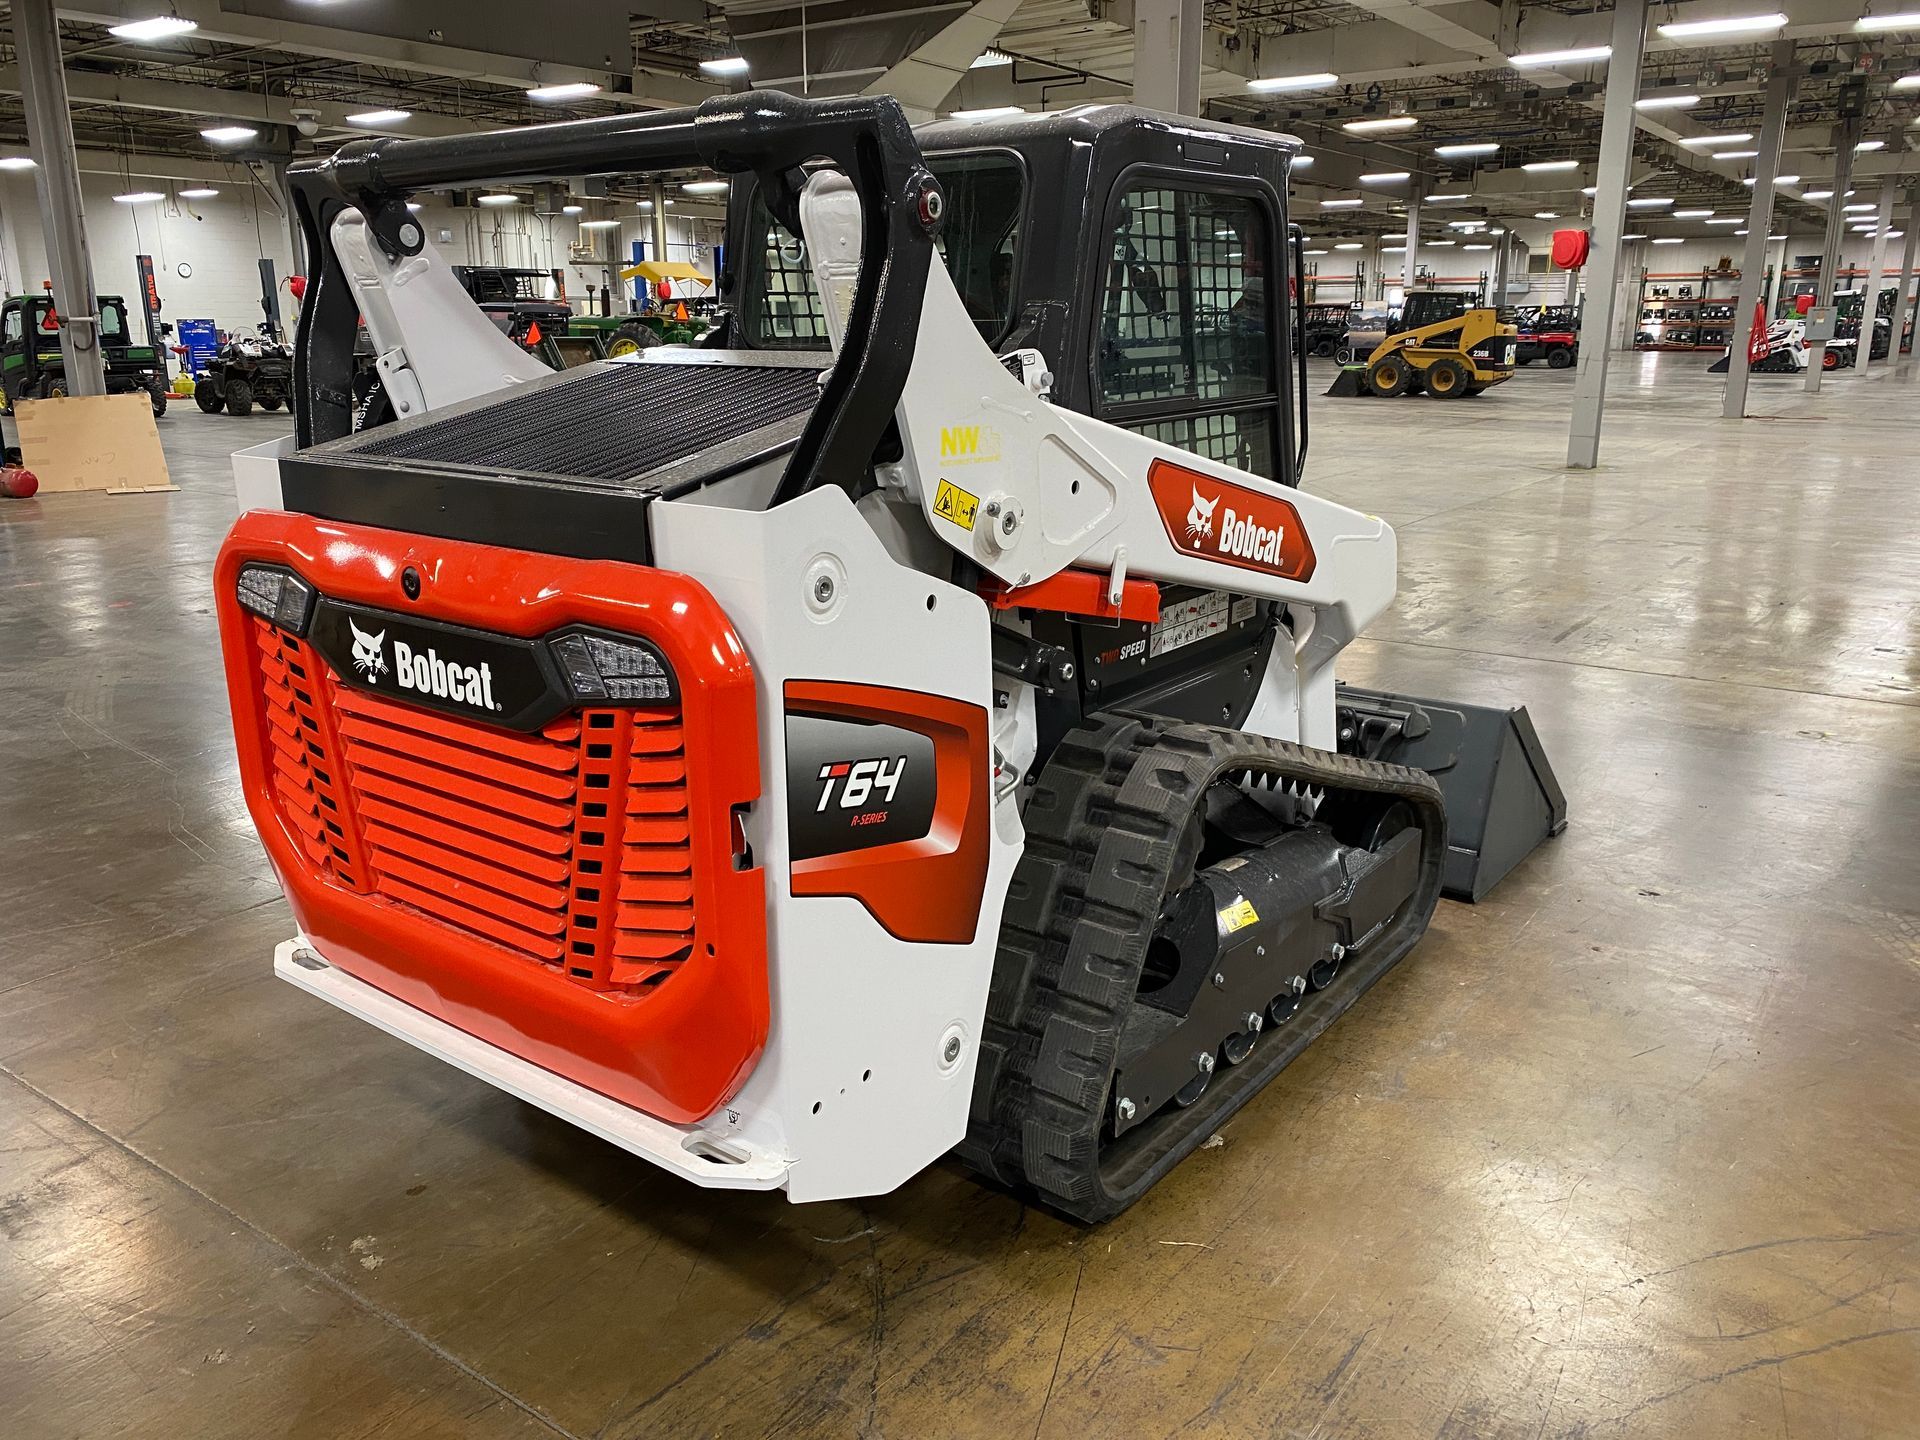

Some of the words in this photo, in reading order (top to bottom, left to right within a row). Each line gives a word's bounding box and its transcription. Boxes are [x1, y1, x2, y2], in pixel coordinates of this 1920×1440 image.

[1703, 71, 1715, 80] 93
[1754, 68, 1766, 77] 95
[147, 274, 158, 309] STRATUS
[1405, 338, 1416, 346] CAT
[355, 395, 374, 429] MSHA
[1219, 507, 1284, 566] Bobcat
[1120, 640, 1146, 660] SPEED
[393, 640, 495, 711] Bobcat
[816, 757, 906, 812] T64
[851, 811, 888, 827] R-SERIES
